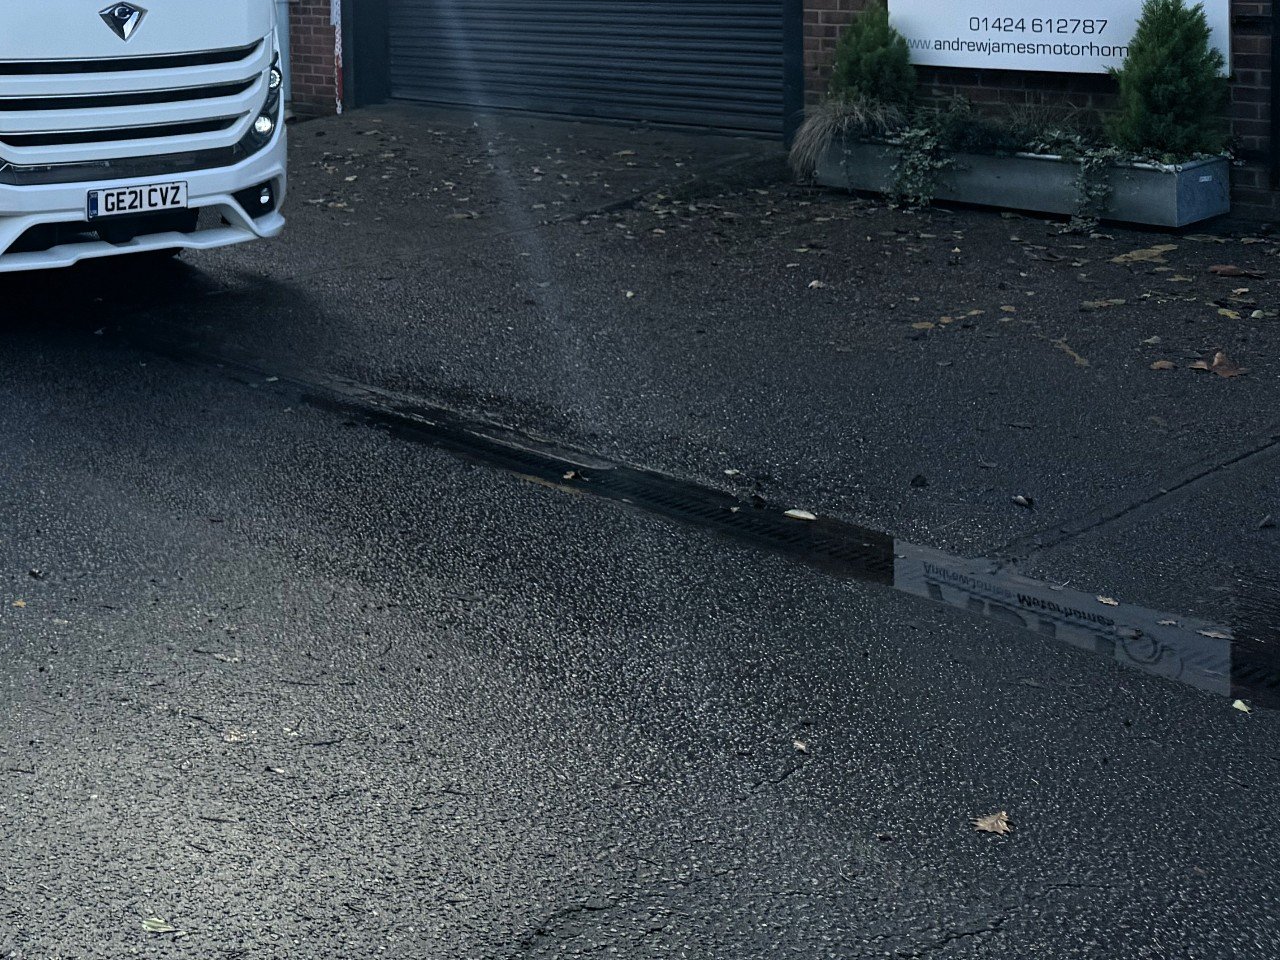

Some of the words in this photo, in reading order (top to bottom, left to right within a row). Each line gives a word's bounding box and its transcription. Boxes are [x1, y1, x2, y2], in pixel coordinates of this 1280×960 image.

[969, 16, 1026, 32] 01424
[1031, 18, 1108, 35] 612787
[907, 37, 1130, 58] ww.andrewjamesmotorhom
[104, 189, 143, 212] GE21
[147, 185, 181, 207] CVZ
